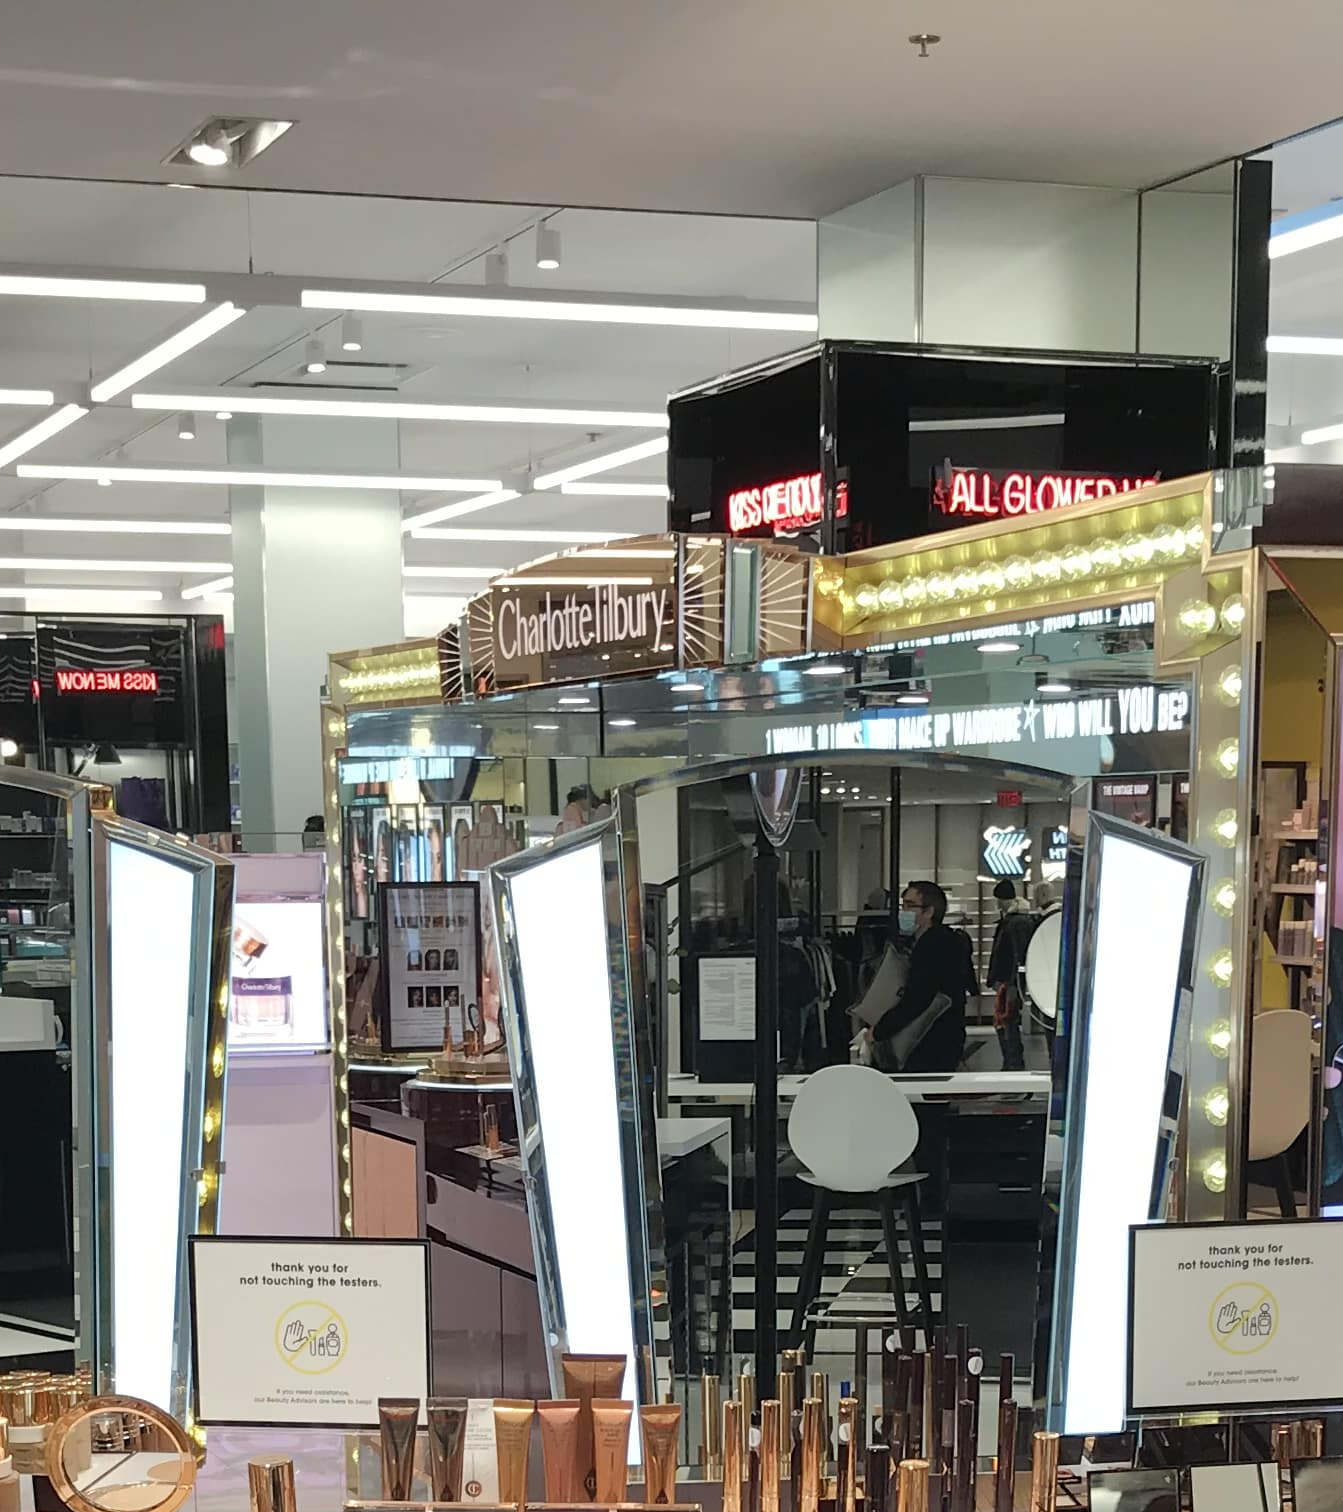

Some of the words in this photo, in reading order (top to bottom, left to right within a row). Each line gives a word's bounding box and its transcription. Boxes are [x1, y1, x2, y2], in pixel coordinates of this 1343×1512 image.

[949, 473, 998, 512] ALL
[1042, 701, 1075, 739] WHO
[1078, 698, 1114, 737] WILL
[1118, 686, 1154, 734] YOU
[1157, 691, 1189, 732] BE?
[1208, 1245, 1241, 1255] thank
[1244, 1245, 1265, 1256] you
[1268, 1243, 1284, 1253] for
[271, 1262, 304, 1273] thank
[308, 1265, 329, 1275] you
[332, 1262, 349, 1273] for
[1178, 1260, 1196, 1270] not
[1199, 1258, 1250, 1270] touching
[1252, 1257, 1271, 1267] the
[1274, 1256, 1314, 1266] testers.
[239, 1276, 259, 1285] not
[262, 1276, 314, 1288] touching
[318, 1276, 337, 1286] the
[340, 1277, 382, 1287] testers.
